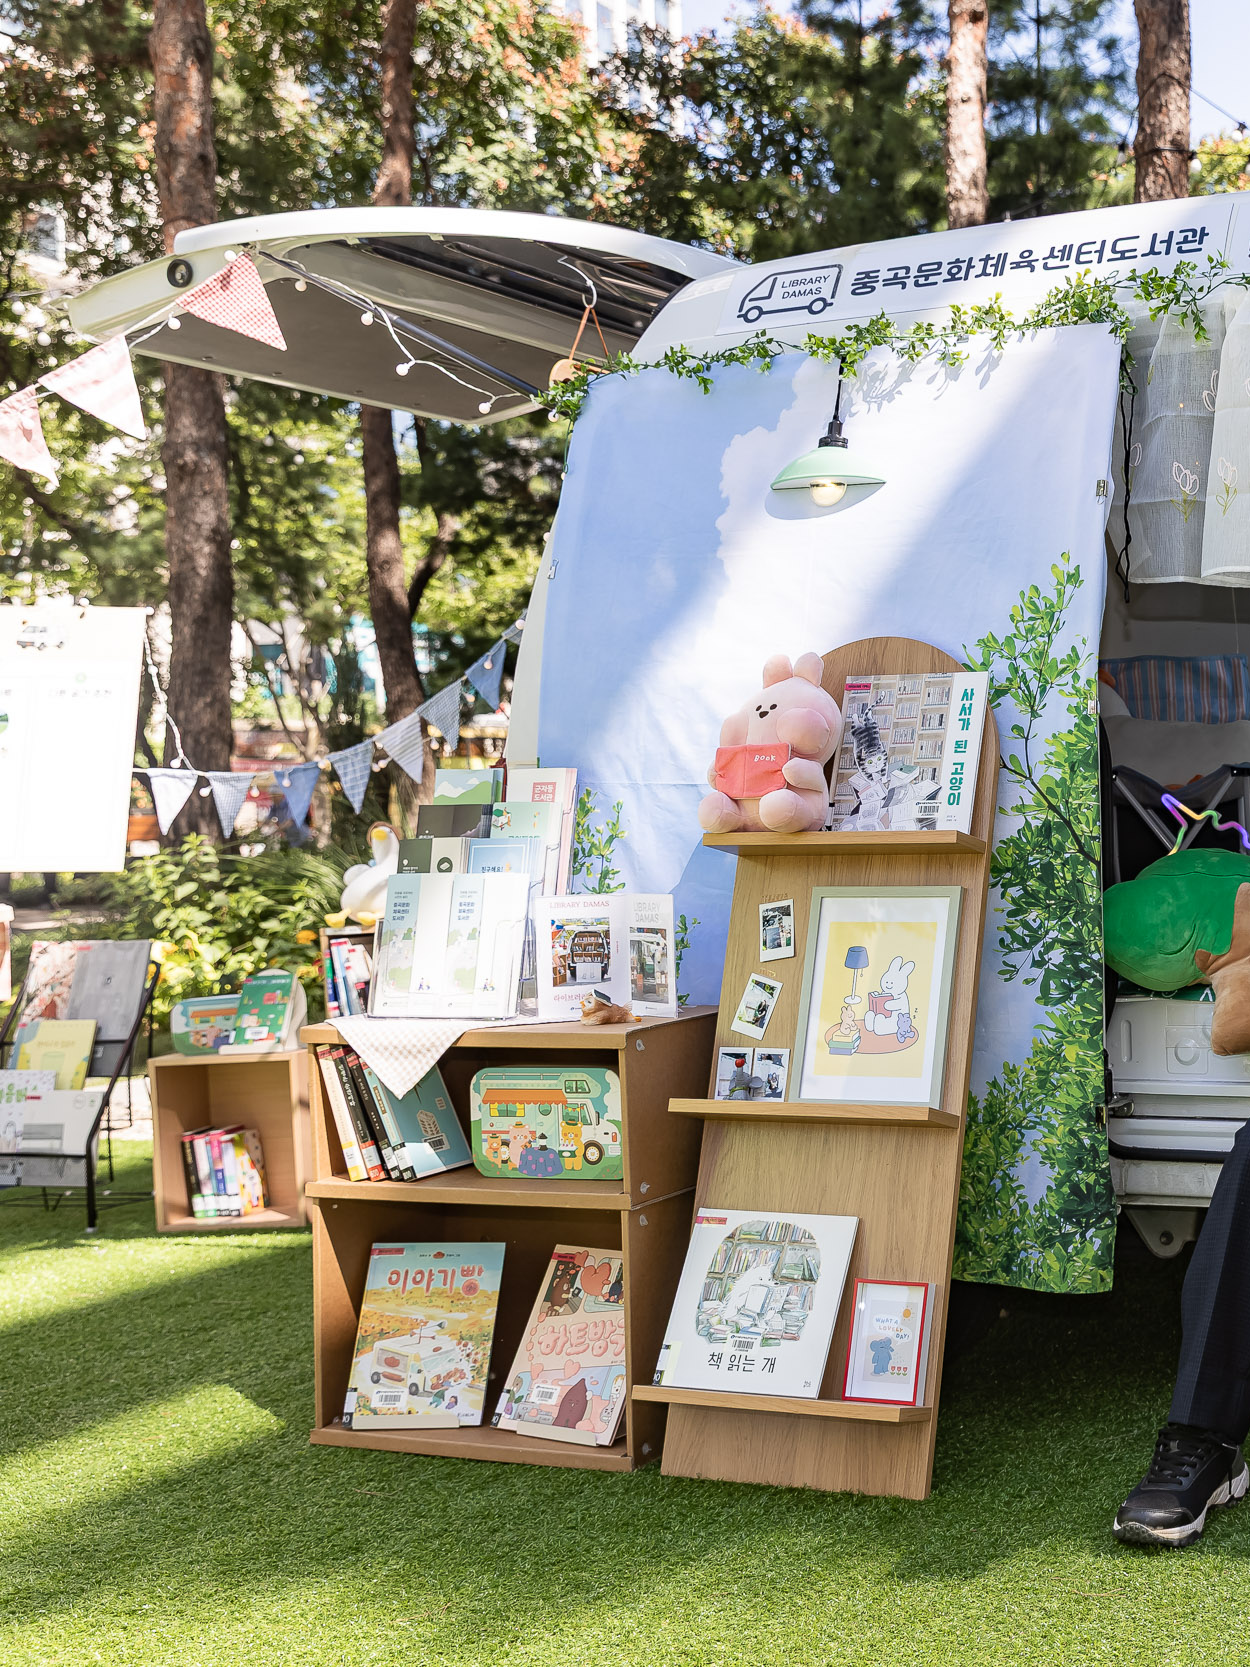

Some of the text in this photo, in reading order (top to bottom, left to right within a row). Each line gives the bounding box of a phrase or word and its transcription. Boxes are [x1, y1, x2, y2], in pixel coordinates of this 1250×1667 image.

[850, 227, 1209, 297] 중곡문화체육센터도서관
[781, 275, 830, 289] LIBRARY
[782, 286, 822, 300] DAMAS
[947, 688, 974, 806] 사서가 된 고양이
[583, 900, 609, 908] DAMAS
[388, 1264, 484, 1296] 이야기빵
[708, 1352, 776, 1373] 책 읽는 개
